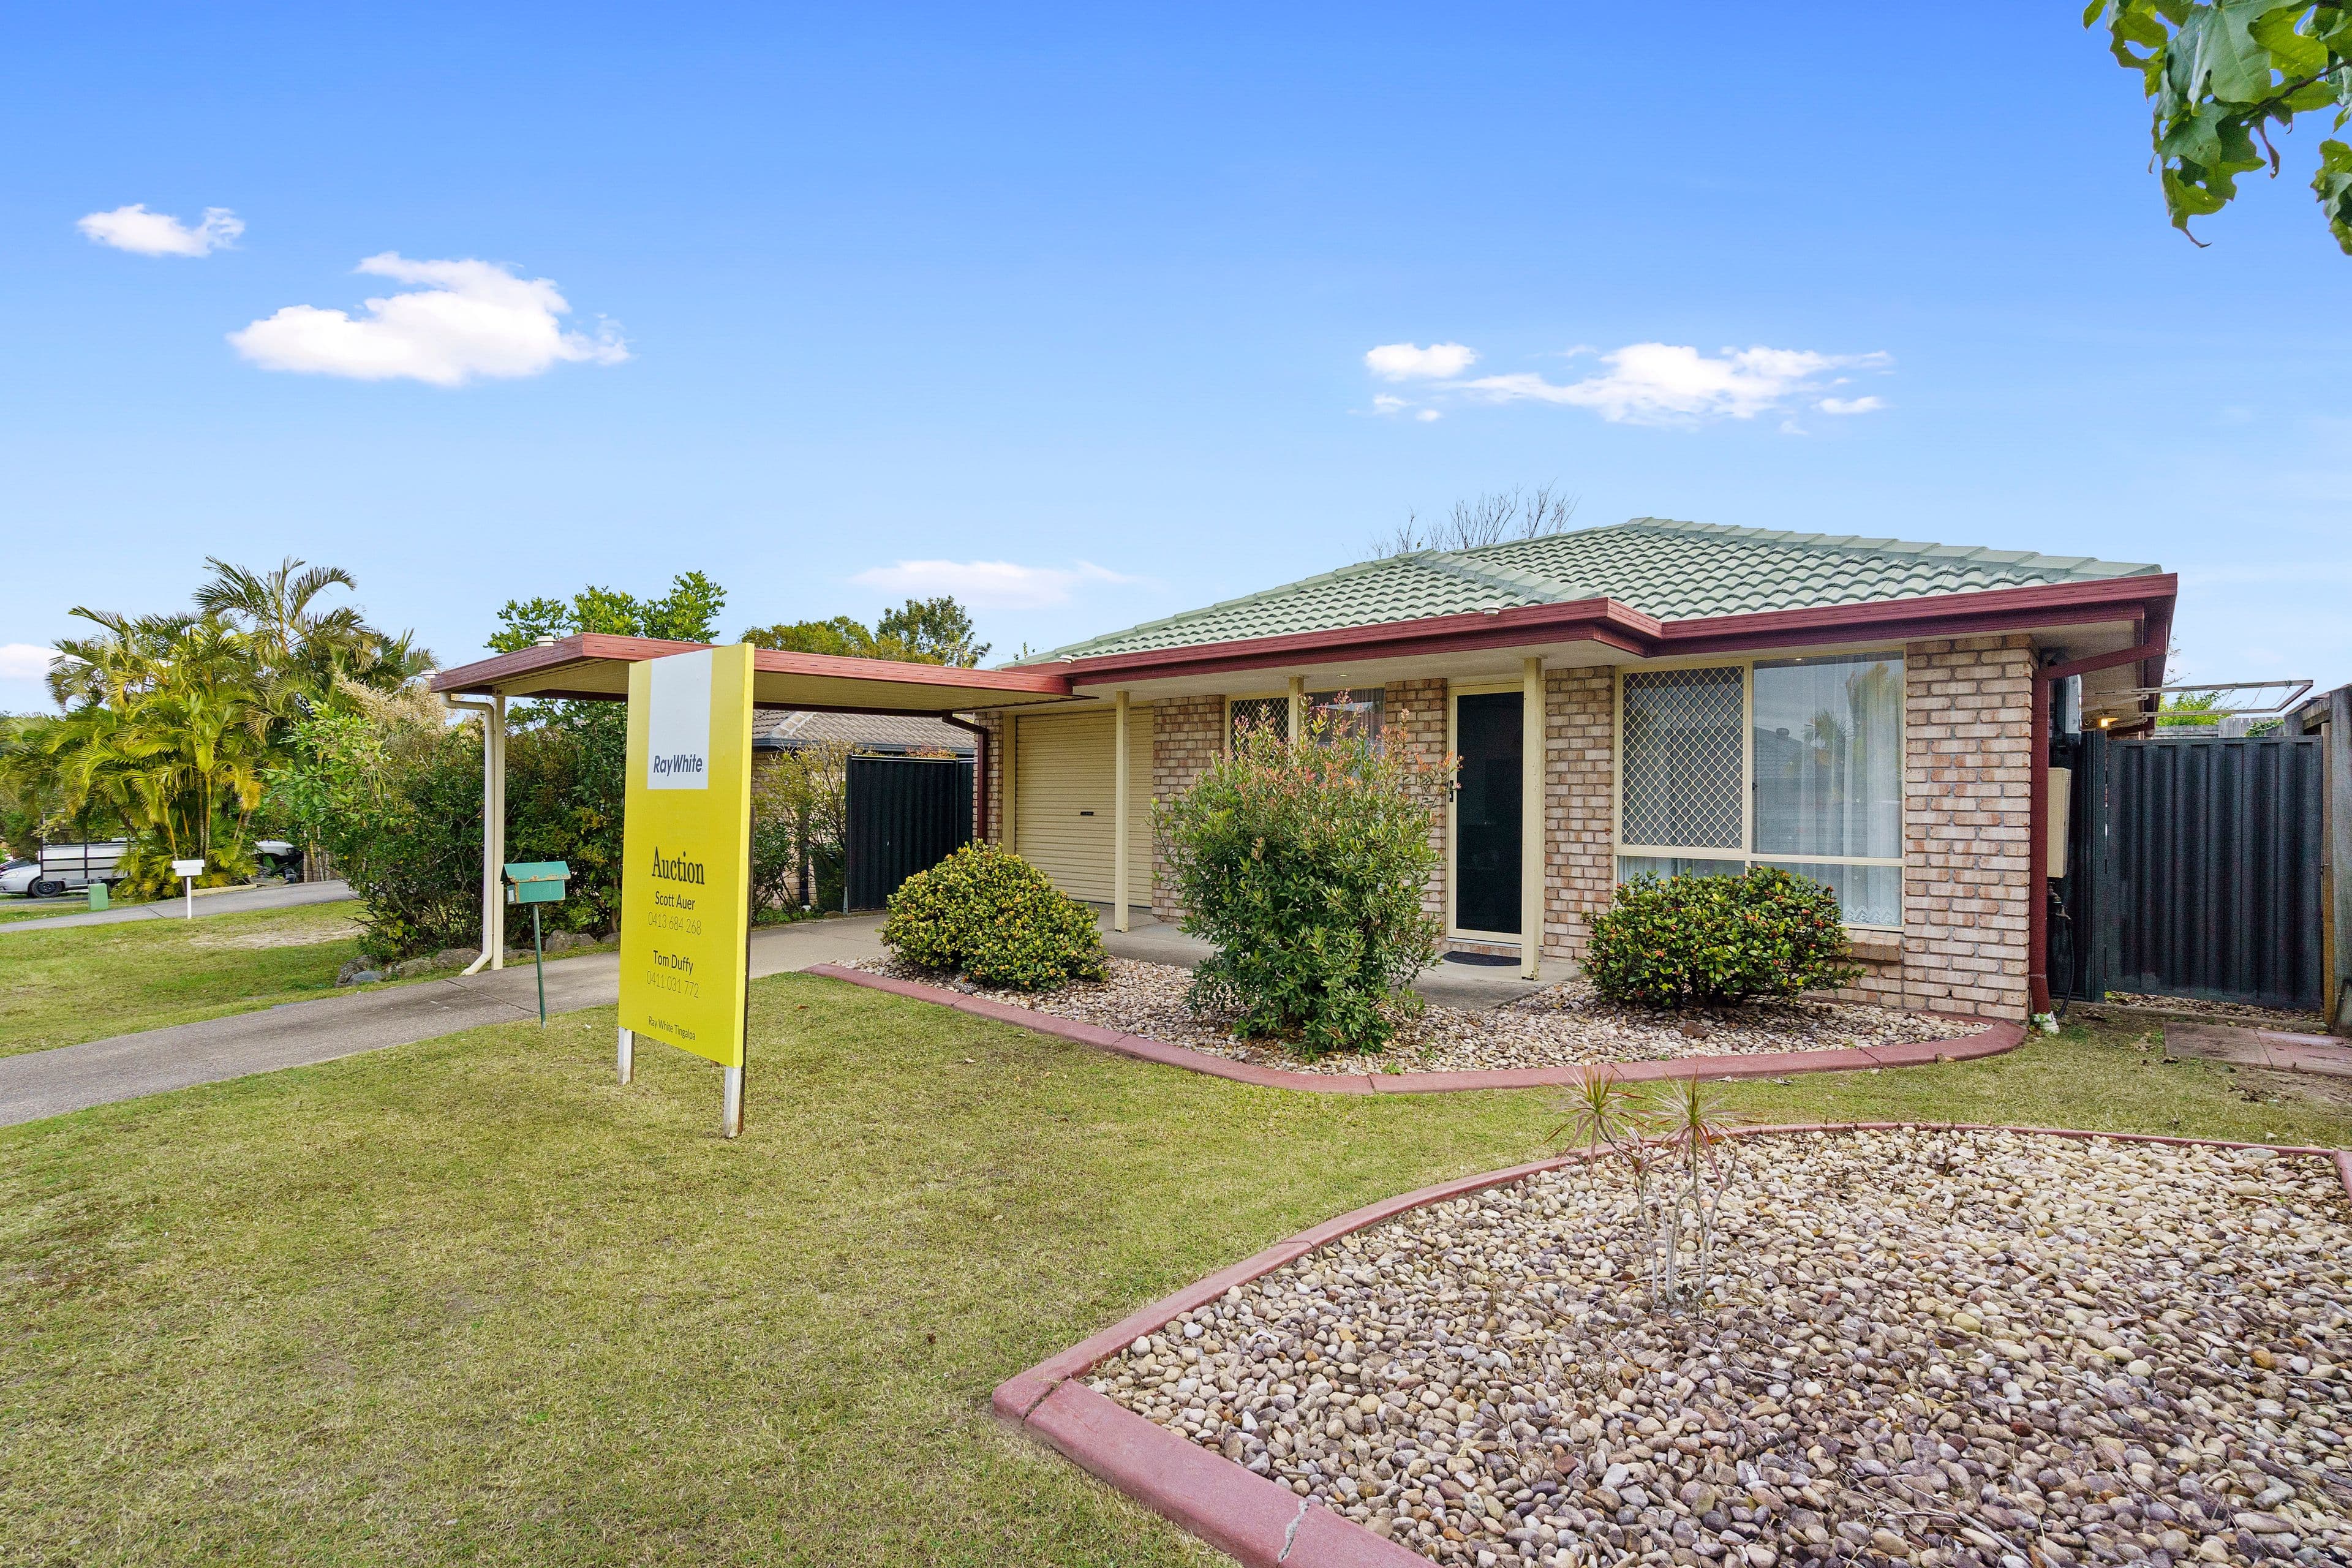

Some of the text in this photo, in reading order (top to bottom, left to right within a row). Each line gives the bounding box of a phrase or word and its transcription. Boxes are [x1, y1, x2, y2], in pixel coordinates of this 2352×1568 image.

[652, 846, 705, 885] Auction
[655, 891, 696, 911] Scott Auer
[648, 911, 701, 935] 0413 684 268
[653, 950, 694, 976] Tom Duffy
[647, 970, 699, 998] 0411 031 772
[648, 1016, 696, 1041] Ray White Tingalpa
